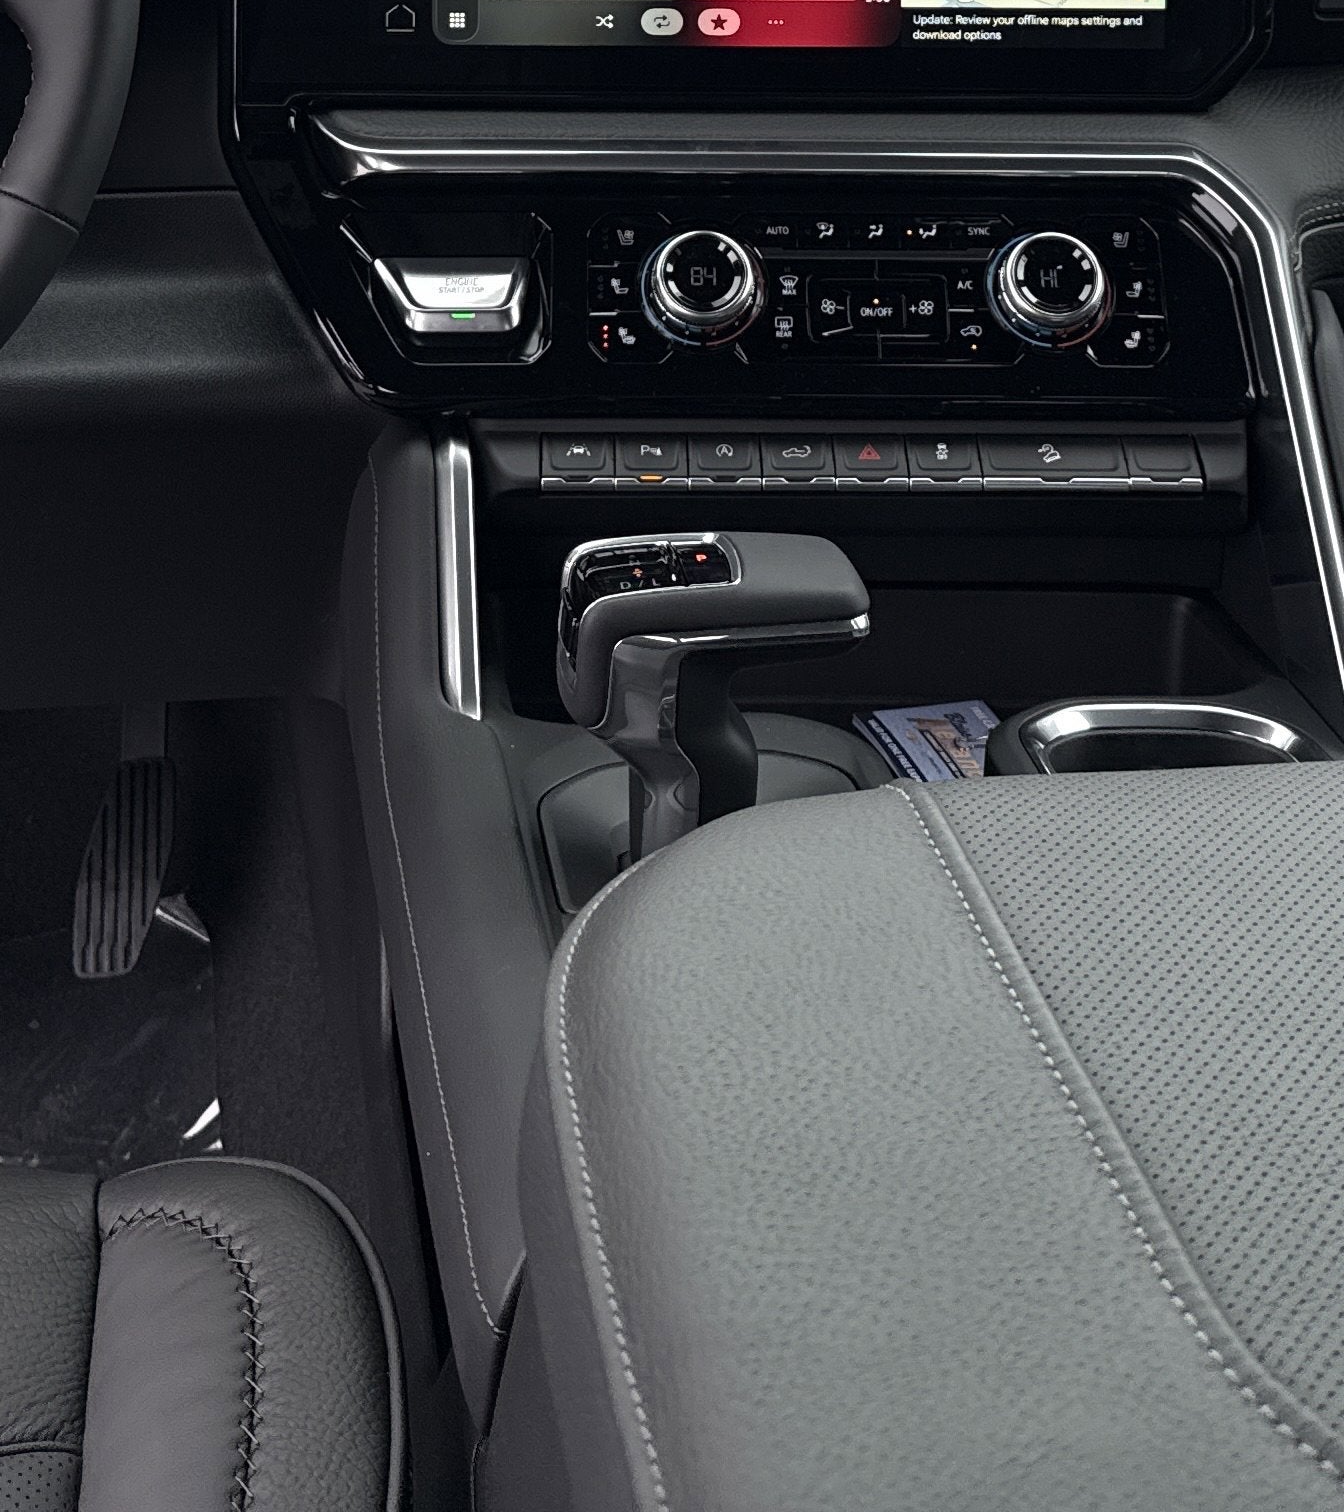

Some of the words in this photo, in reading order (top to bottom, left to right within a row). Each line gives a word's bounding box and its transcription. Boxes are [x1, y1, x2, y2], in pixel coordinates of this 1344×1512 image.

[912, 15, 954, 27] Update:
[955, 15, 991, 26] Review
[992, 18, 1015, 28] your
[1017, 15, 1049, 26] offline
[1051, 17, 1079, 28] maps
[1081, 15, 1121, 28] settings
[1123, 15, 1143, 26] and
[912, 29, 961, 40] download
[963, 30, 1002, 42] options
[766, 226, 790, 236] AUTO
[967, 226, 991, 236] SYNC
[690, 266, 717, 286] 84
[957, 280, 974, 290] A/C
[860, 307, 894, 317] ON/OFF
